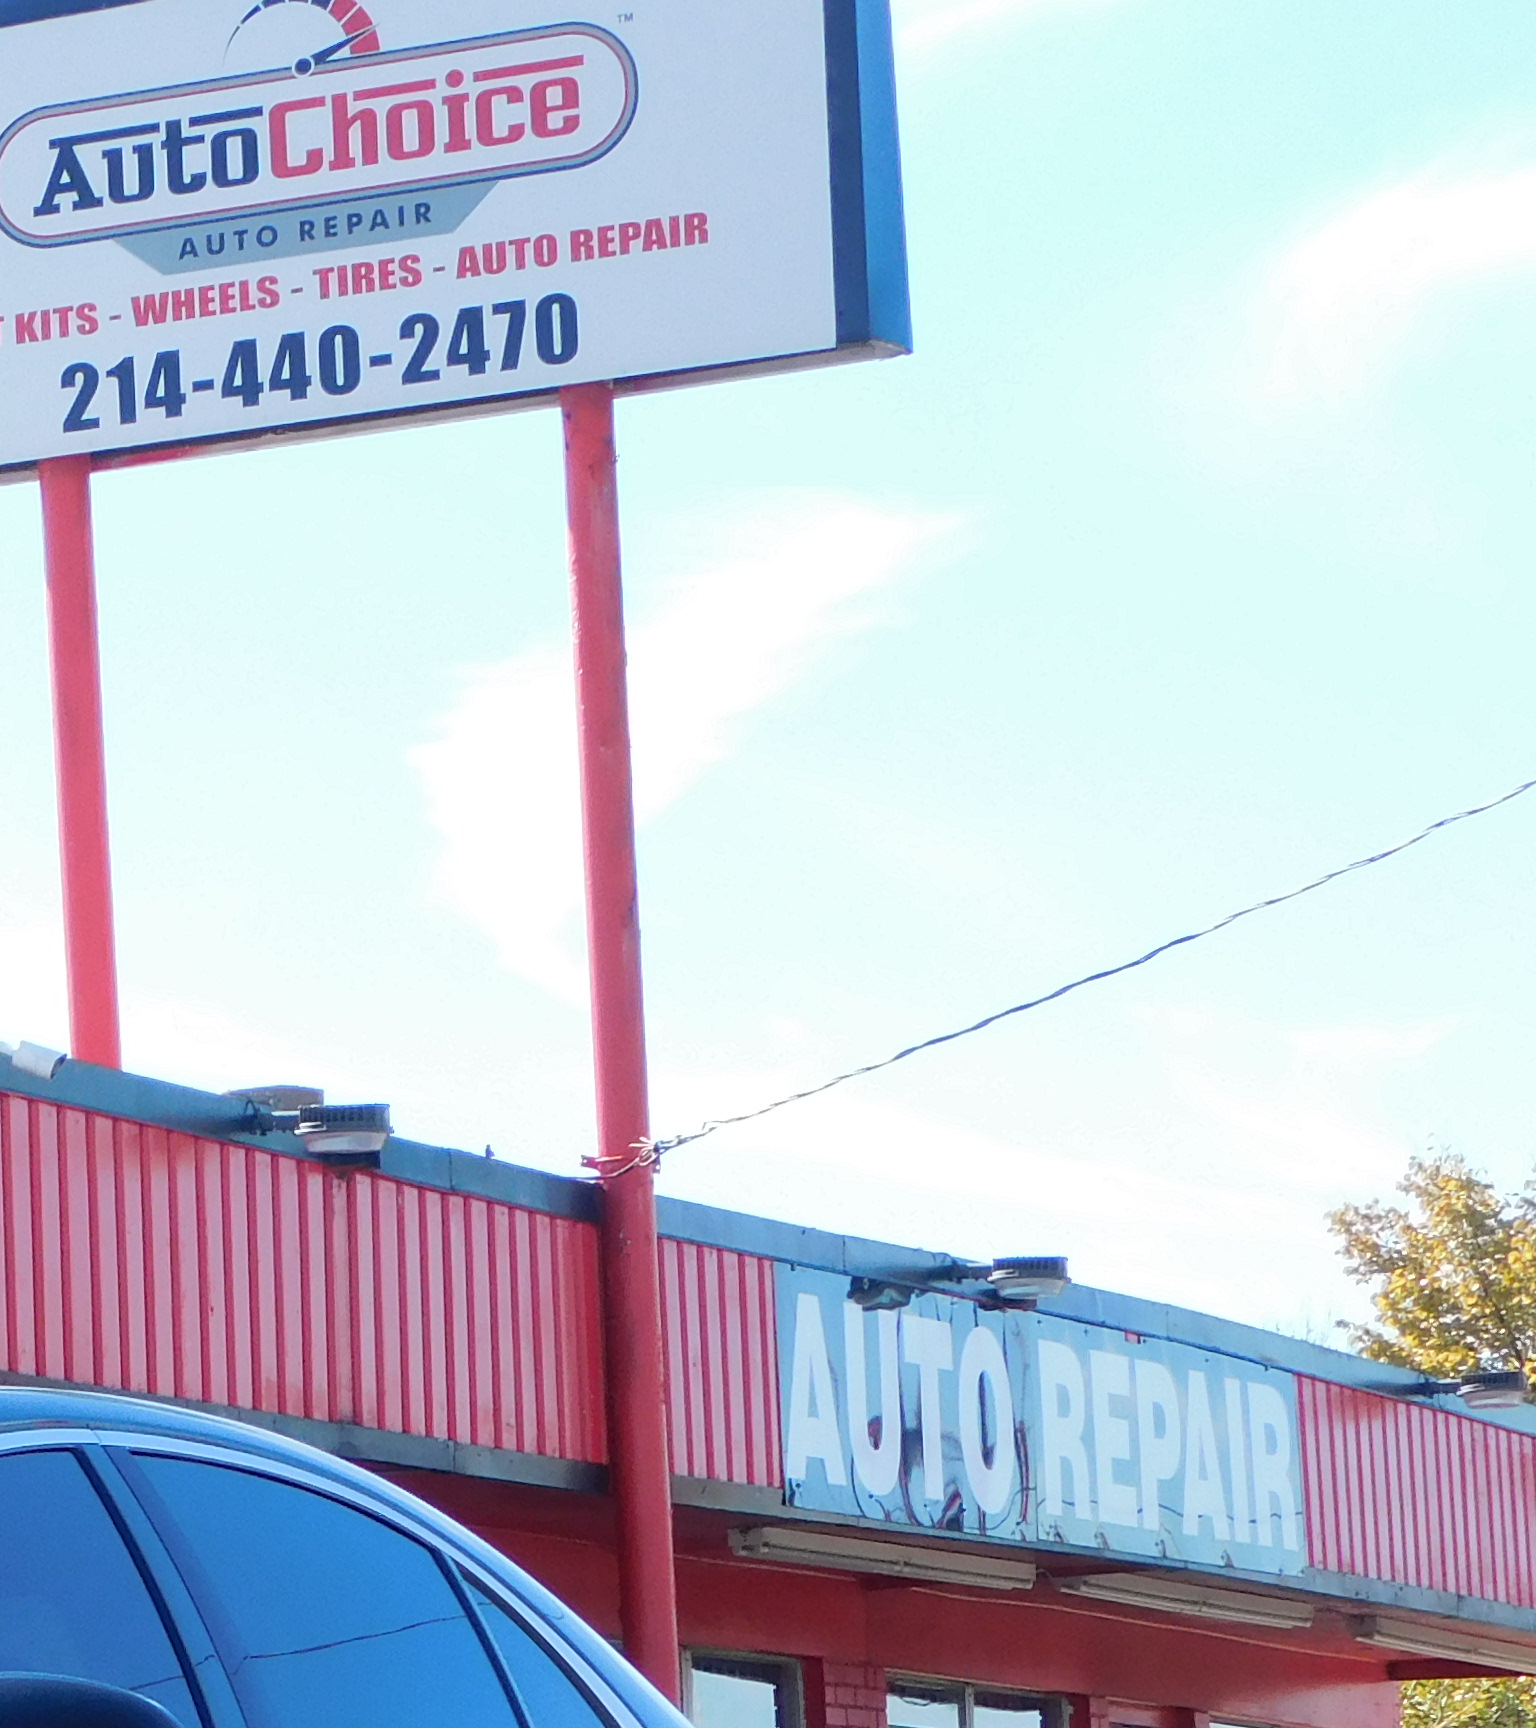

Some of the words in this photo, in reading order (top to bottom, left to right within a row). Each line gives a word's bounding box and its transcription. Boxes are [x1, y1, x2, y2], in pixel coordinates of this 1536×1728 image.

[32, 55, 584, 218] AutoChoice
[15, 303, 99, 344] KITS
[131, 276, 280, 327] WHEELS
[312, 254, 422, 299] TIRES
[456, 233, 558, 279] AUTO
[569, 212, 709, 262] REPAIR
[179, 225, 279, 260] AUTO
[299, 202, 433, 242] REPAIR
[60, 292, 578, 433] 214-440-2470
[785, 1293, 1016, 1515] AUTO
[1036, 1339, 1297, 1552] REPAIR
